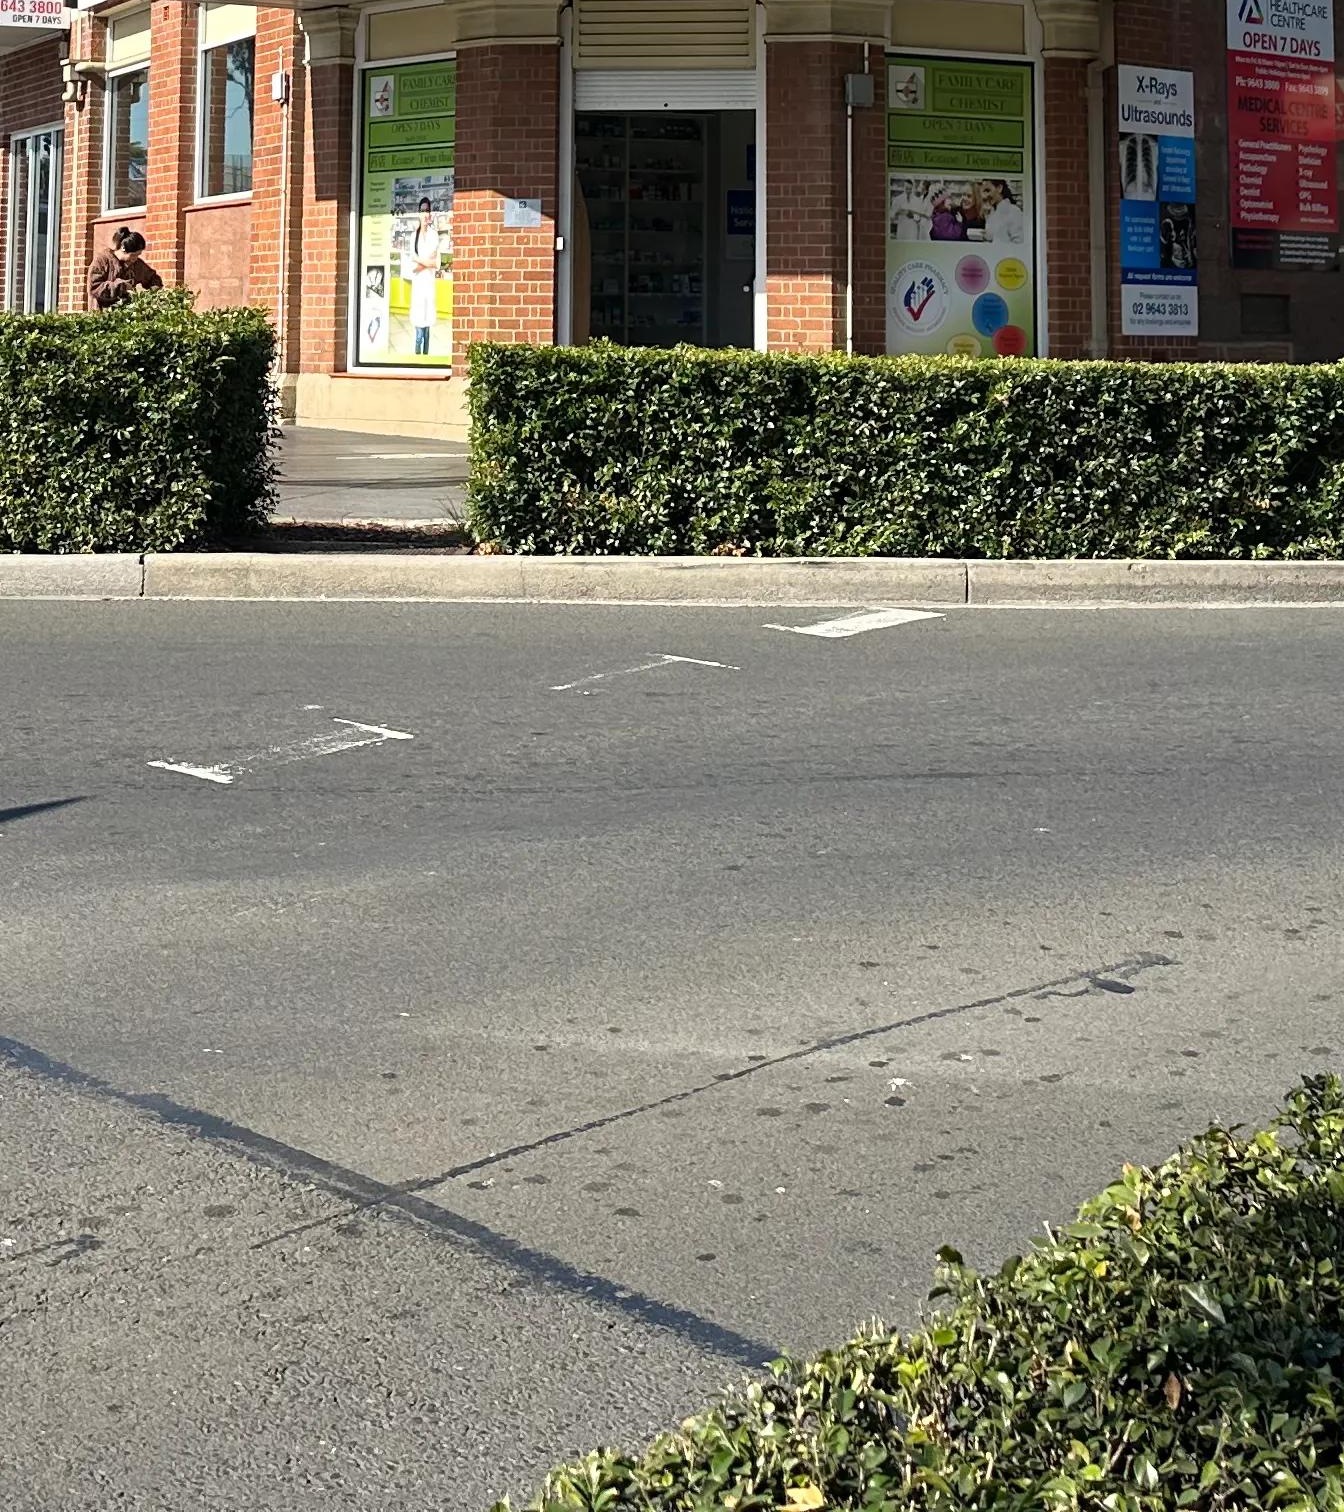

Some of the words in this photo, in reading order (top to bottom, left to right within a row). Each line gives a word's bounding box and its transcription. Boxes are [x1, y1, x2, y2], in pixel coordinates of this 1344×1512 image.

[29, 0, 62, 15] 3800
[1269, 0, 1329, 20] HEALTHCARE
[12, 14, 33, 24] OPEN
[36, 15, 41, 23] 7
[42, 16, 62, 25] DAYS
[1270, 14, 1306, 31] CENTRE
[1243, 31, 1277, 51] OPEN
[1280, 36, 1288, 52] 7
[1290, 37, 1321, 57] DAYS
[434, 72, 455, 88] CAR
[938, 75, 984, 89] FAMILY
[985, 77, 1018, 90] CARE
[1136, 76, 1178, 99] X-Rays
[409, 96, 449, 111] CHEMIST
[949, 97, 1007, 112] CHEMIST
[1237, 95, 1286, 116] MEDICAL
[1288, 101, 1329, 119] CENTRE
[1121, 103, 1193, 127] Ultrasounds
[922, 119, 954, 131] OPEN
[964, 121, 995, 133] DAYS
[1259, 117, 1310, 137] SERVICES
[1132, 302, 1144, 315] 02
[1146, 302, 1167, 315] 9643
